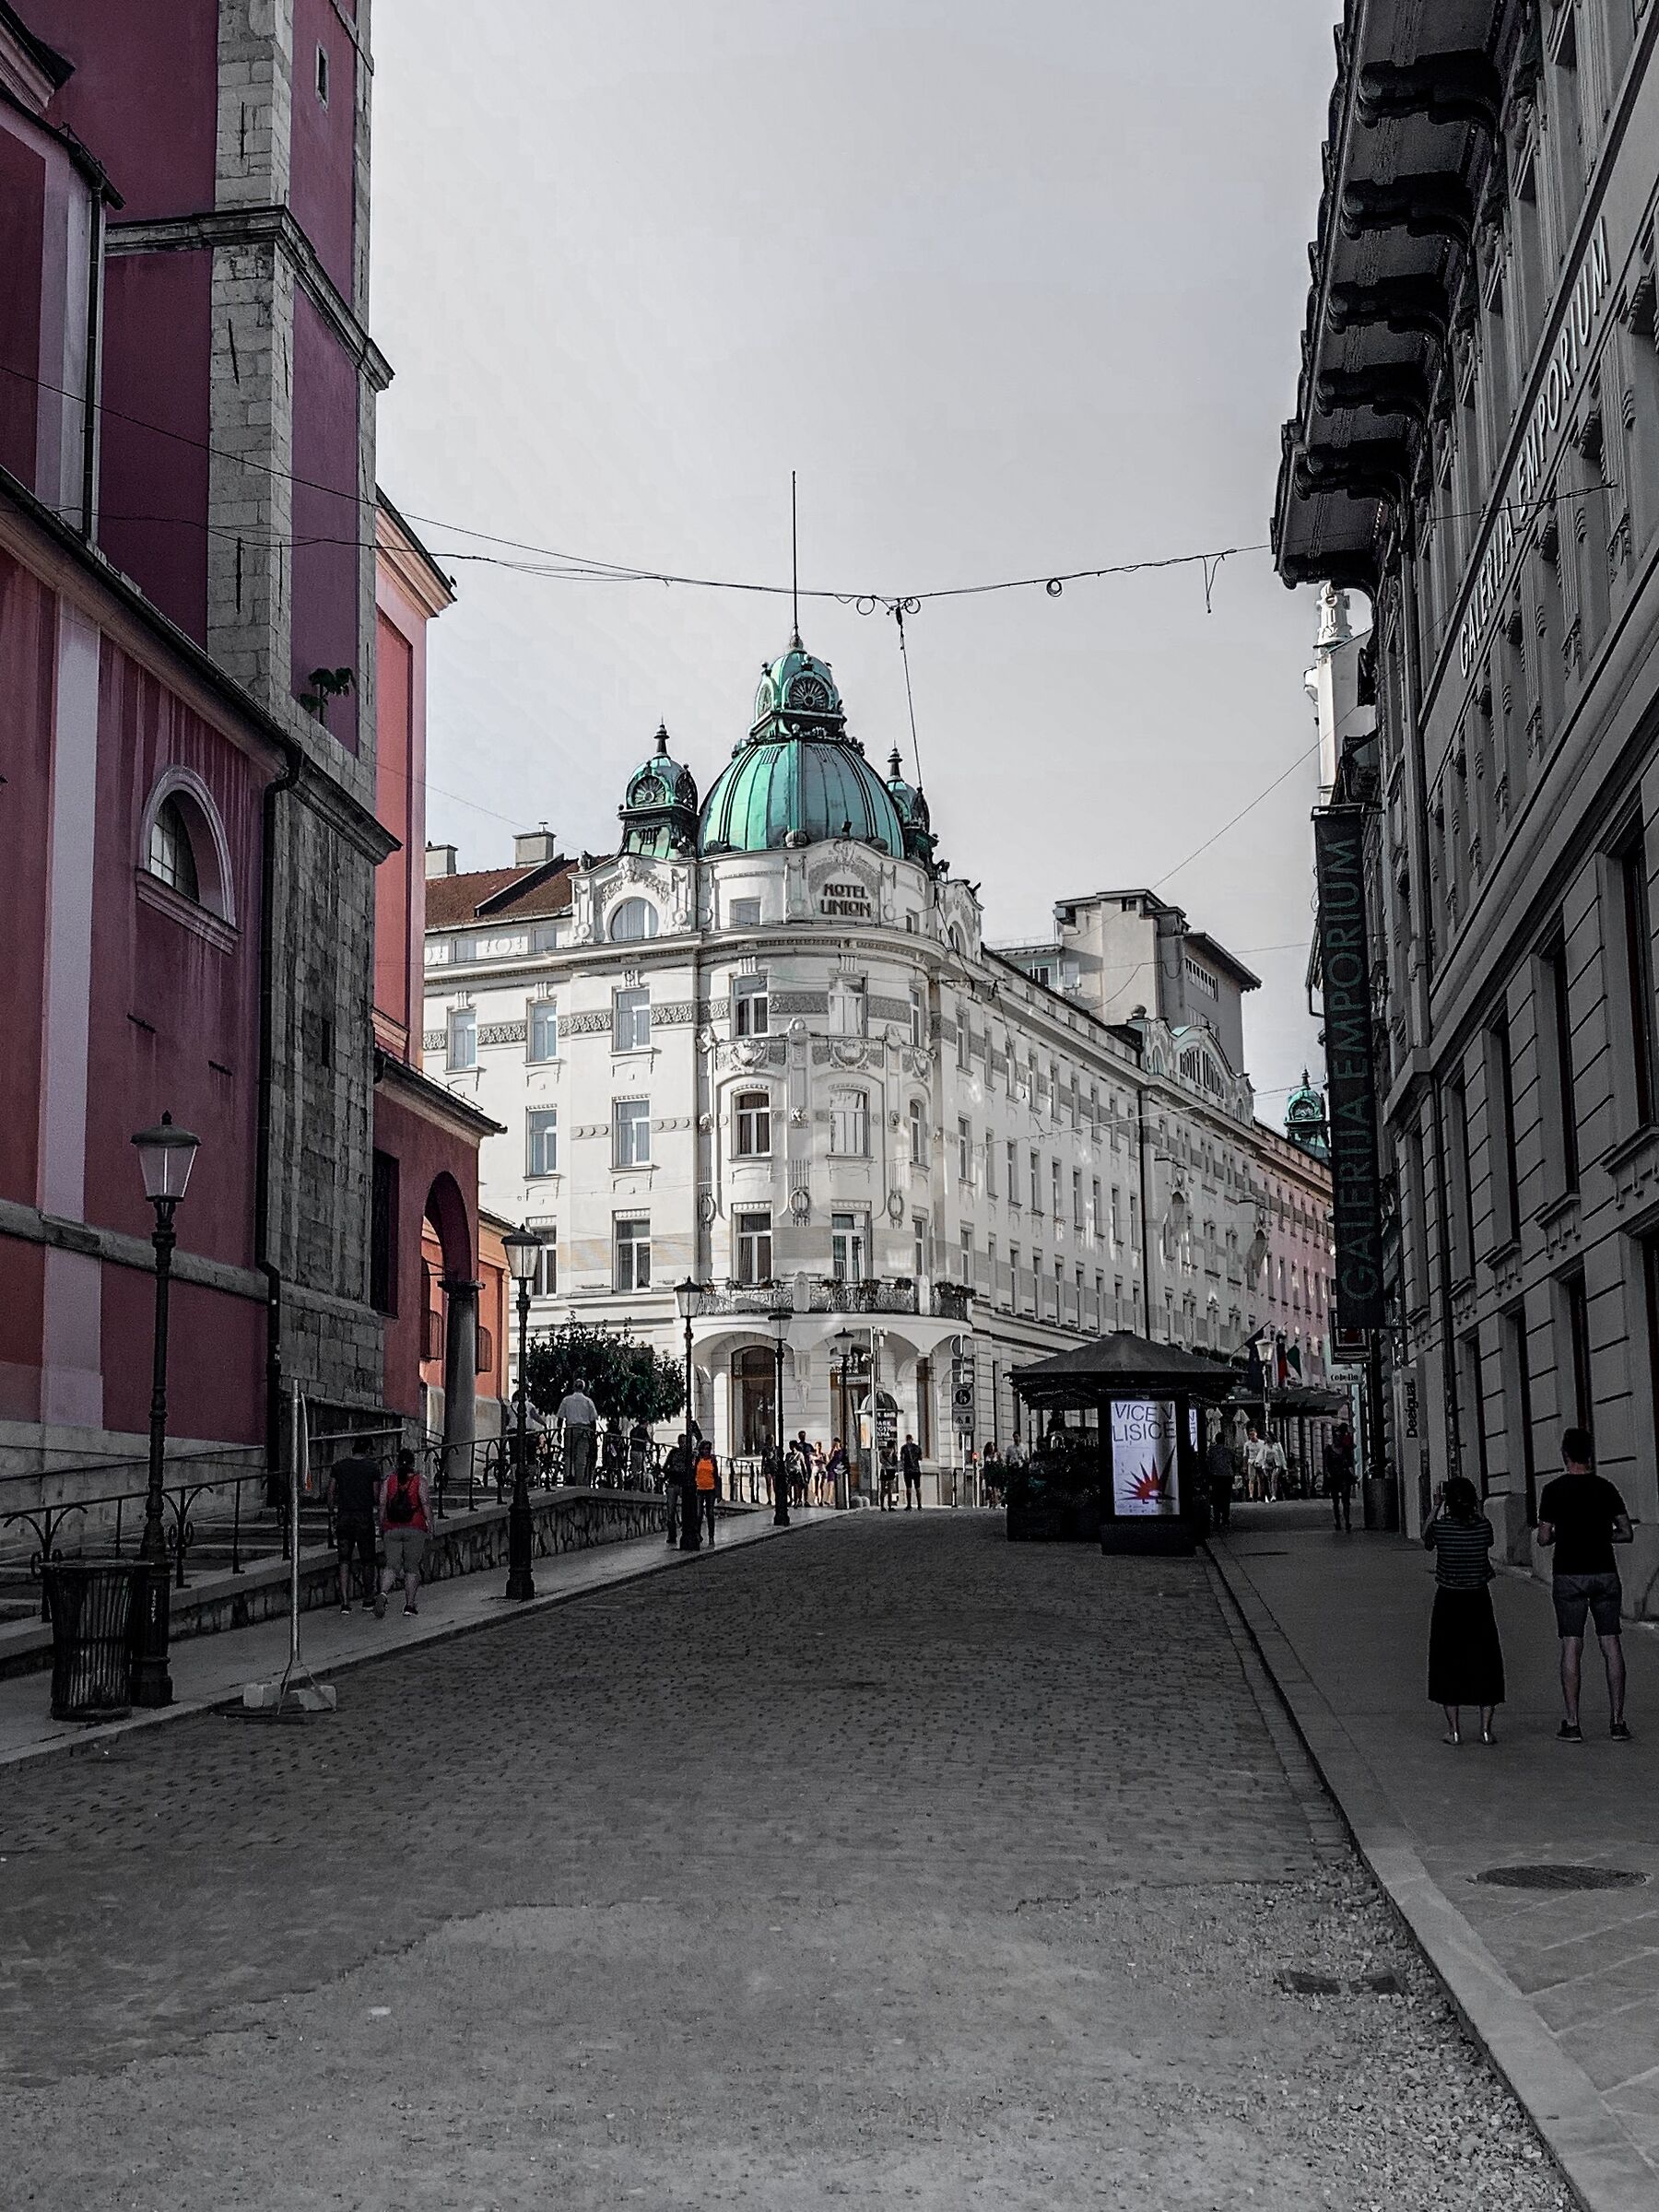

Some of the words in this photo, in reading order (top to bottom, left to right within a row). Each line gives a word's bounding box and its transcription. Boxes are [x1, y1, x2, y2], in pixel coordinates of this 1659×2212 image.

[1461, 499, 1516, 678] GALERIJA
[1518, 217, 1611, 523] EMPORIUM
[823, 883, 868, 900] HOTEL
[820, 900, 871, 918] UNION
[1324, 839, 1370, 1080] EMPORIUM
[1335, 1094, 1379, 1300] GALERIJA
[1114, 1403, 1158, 1422] VICE
[1112, 1421, 1176, 1441] LISICE
